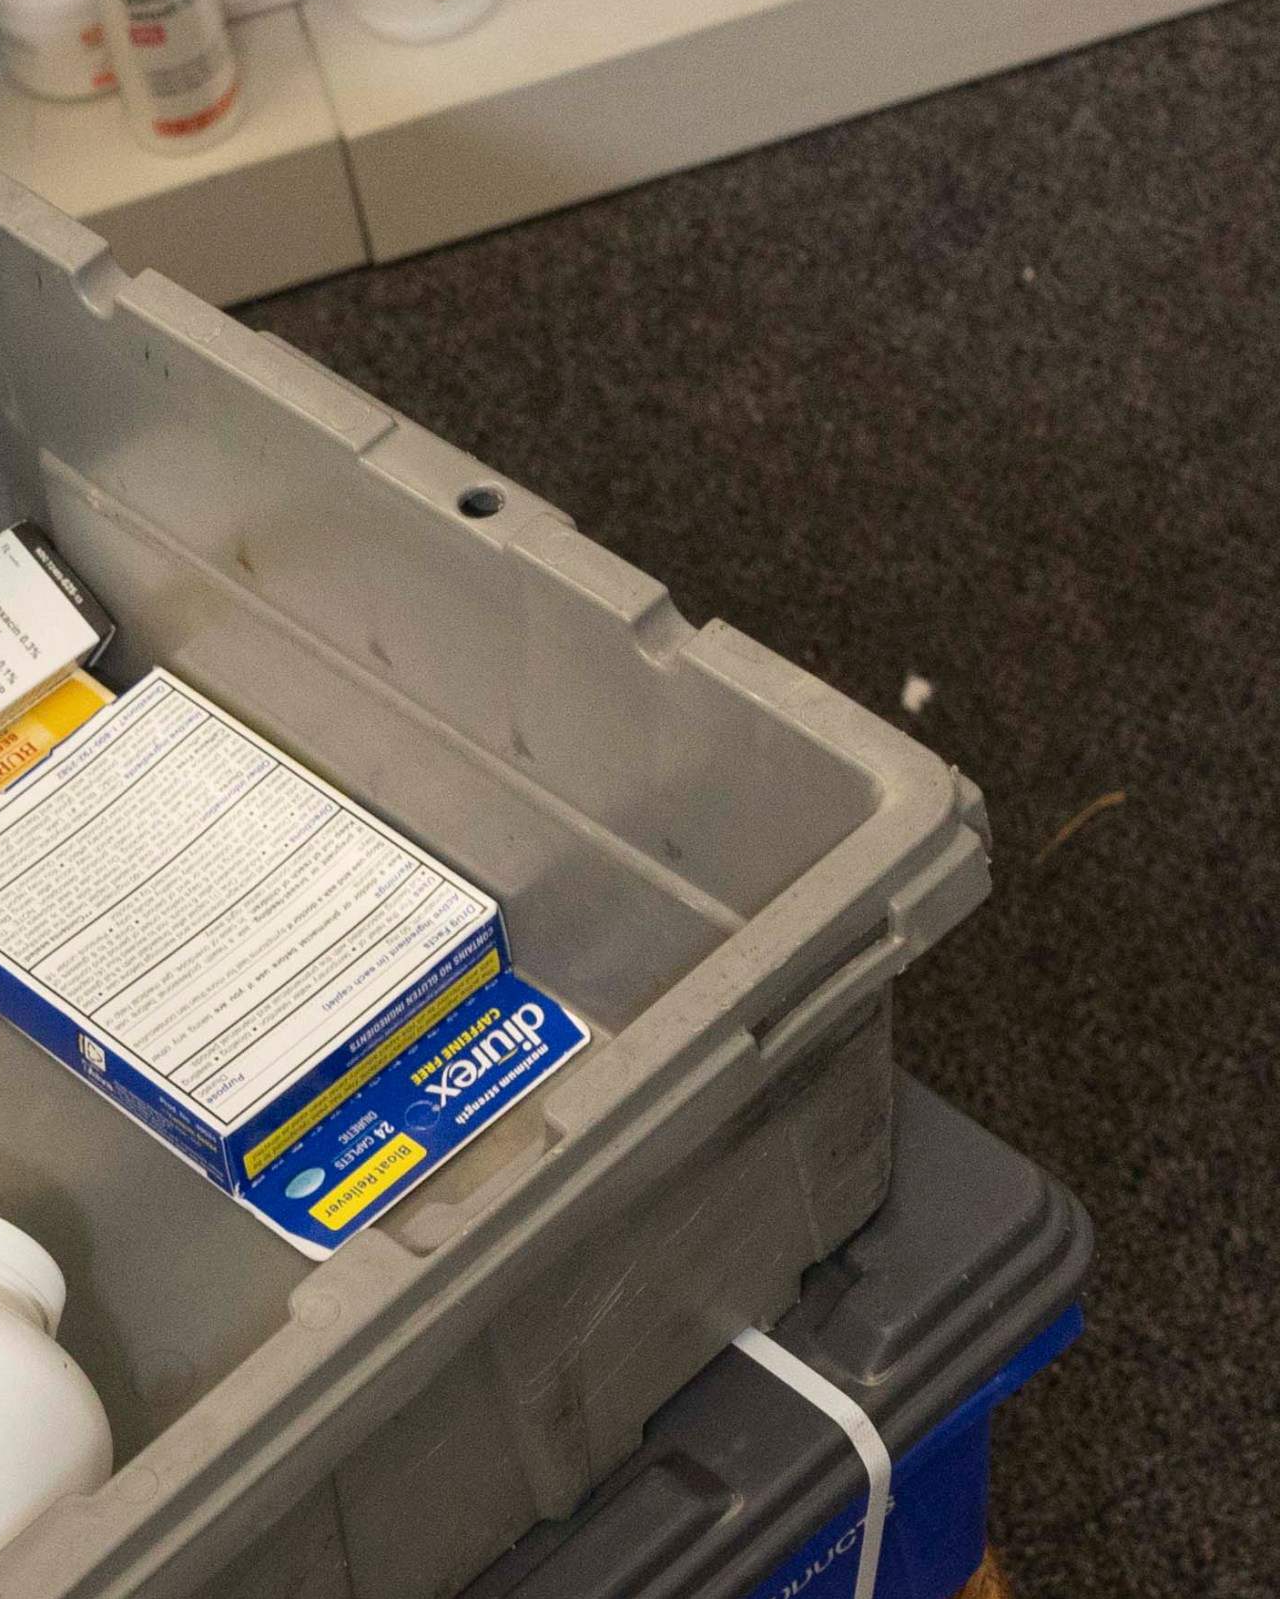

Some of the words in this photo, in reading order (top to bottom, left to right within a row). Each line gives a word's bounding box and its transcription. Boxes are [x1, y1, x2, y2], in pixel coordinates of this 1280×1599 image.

[19, 634, 41, 659] 0.3%
[120, 738, 172, 779] ingredients
[243, 759, 271, 781] Other
[196, 779, 249, 822] information
[285, 803, 334, 842] Directions
[370, 861, 416, 898] Warnings
[410, 876, 436, 897] Uses
[431, 893, 462, 918] Active
[448, 904, 476, 927] Drug
[386, 917, 433, 956] ingredient
[422, 926, 451, 950] Facts
[451, 926, 496, 965] CONTAINS
[353, 966, 377, 985] each
[437, 961, 454, 977] NO
[321, 984, 354, 1011] caplet)
[404, 973, 440, 1005] GLUTEN
[347, 1001, 407, 1052] INGREDIENTS
[439, 1006, 501, 1060] CAFFEINE
[410, 1056, 443, 1085] FREE
[424, 1000, 553, 1114] diurex
[498, 1044, 550, 1088] maximum
[205, 1072, 245, 1105] Purpose
[454, 1083, 501, 1125] strength
[337, 1109, 377, 1145] DIURETIC
[373, 1120, 394, 1140] 24
[333, 1134, 375, 1171] CAPLETS
[375, 1143, 411, 1176] Bloat
[323, 1172, 377, 1219] Reliever
